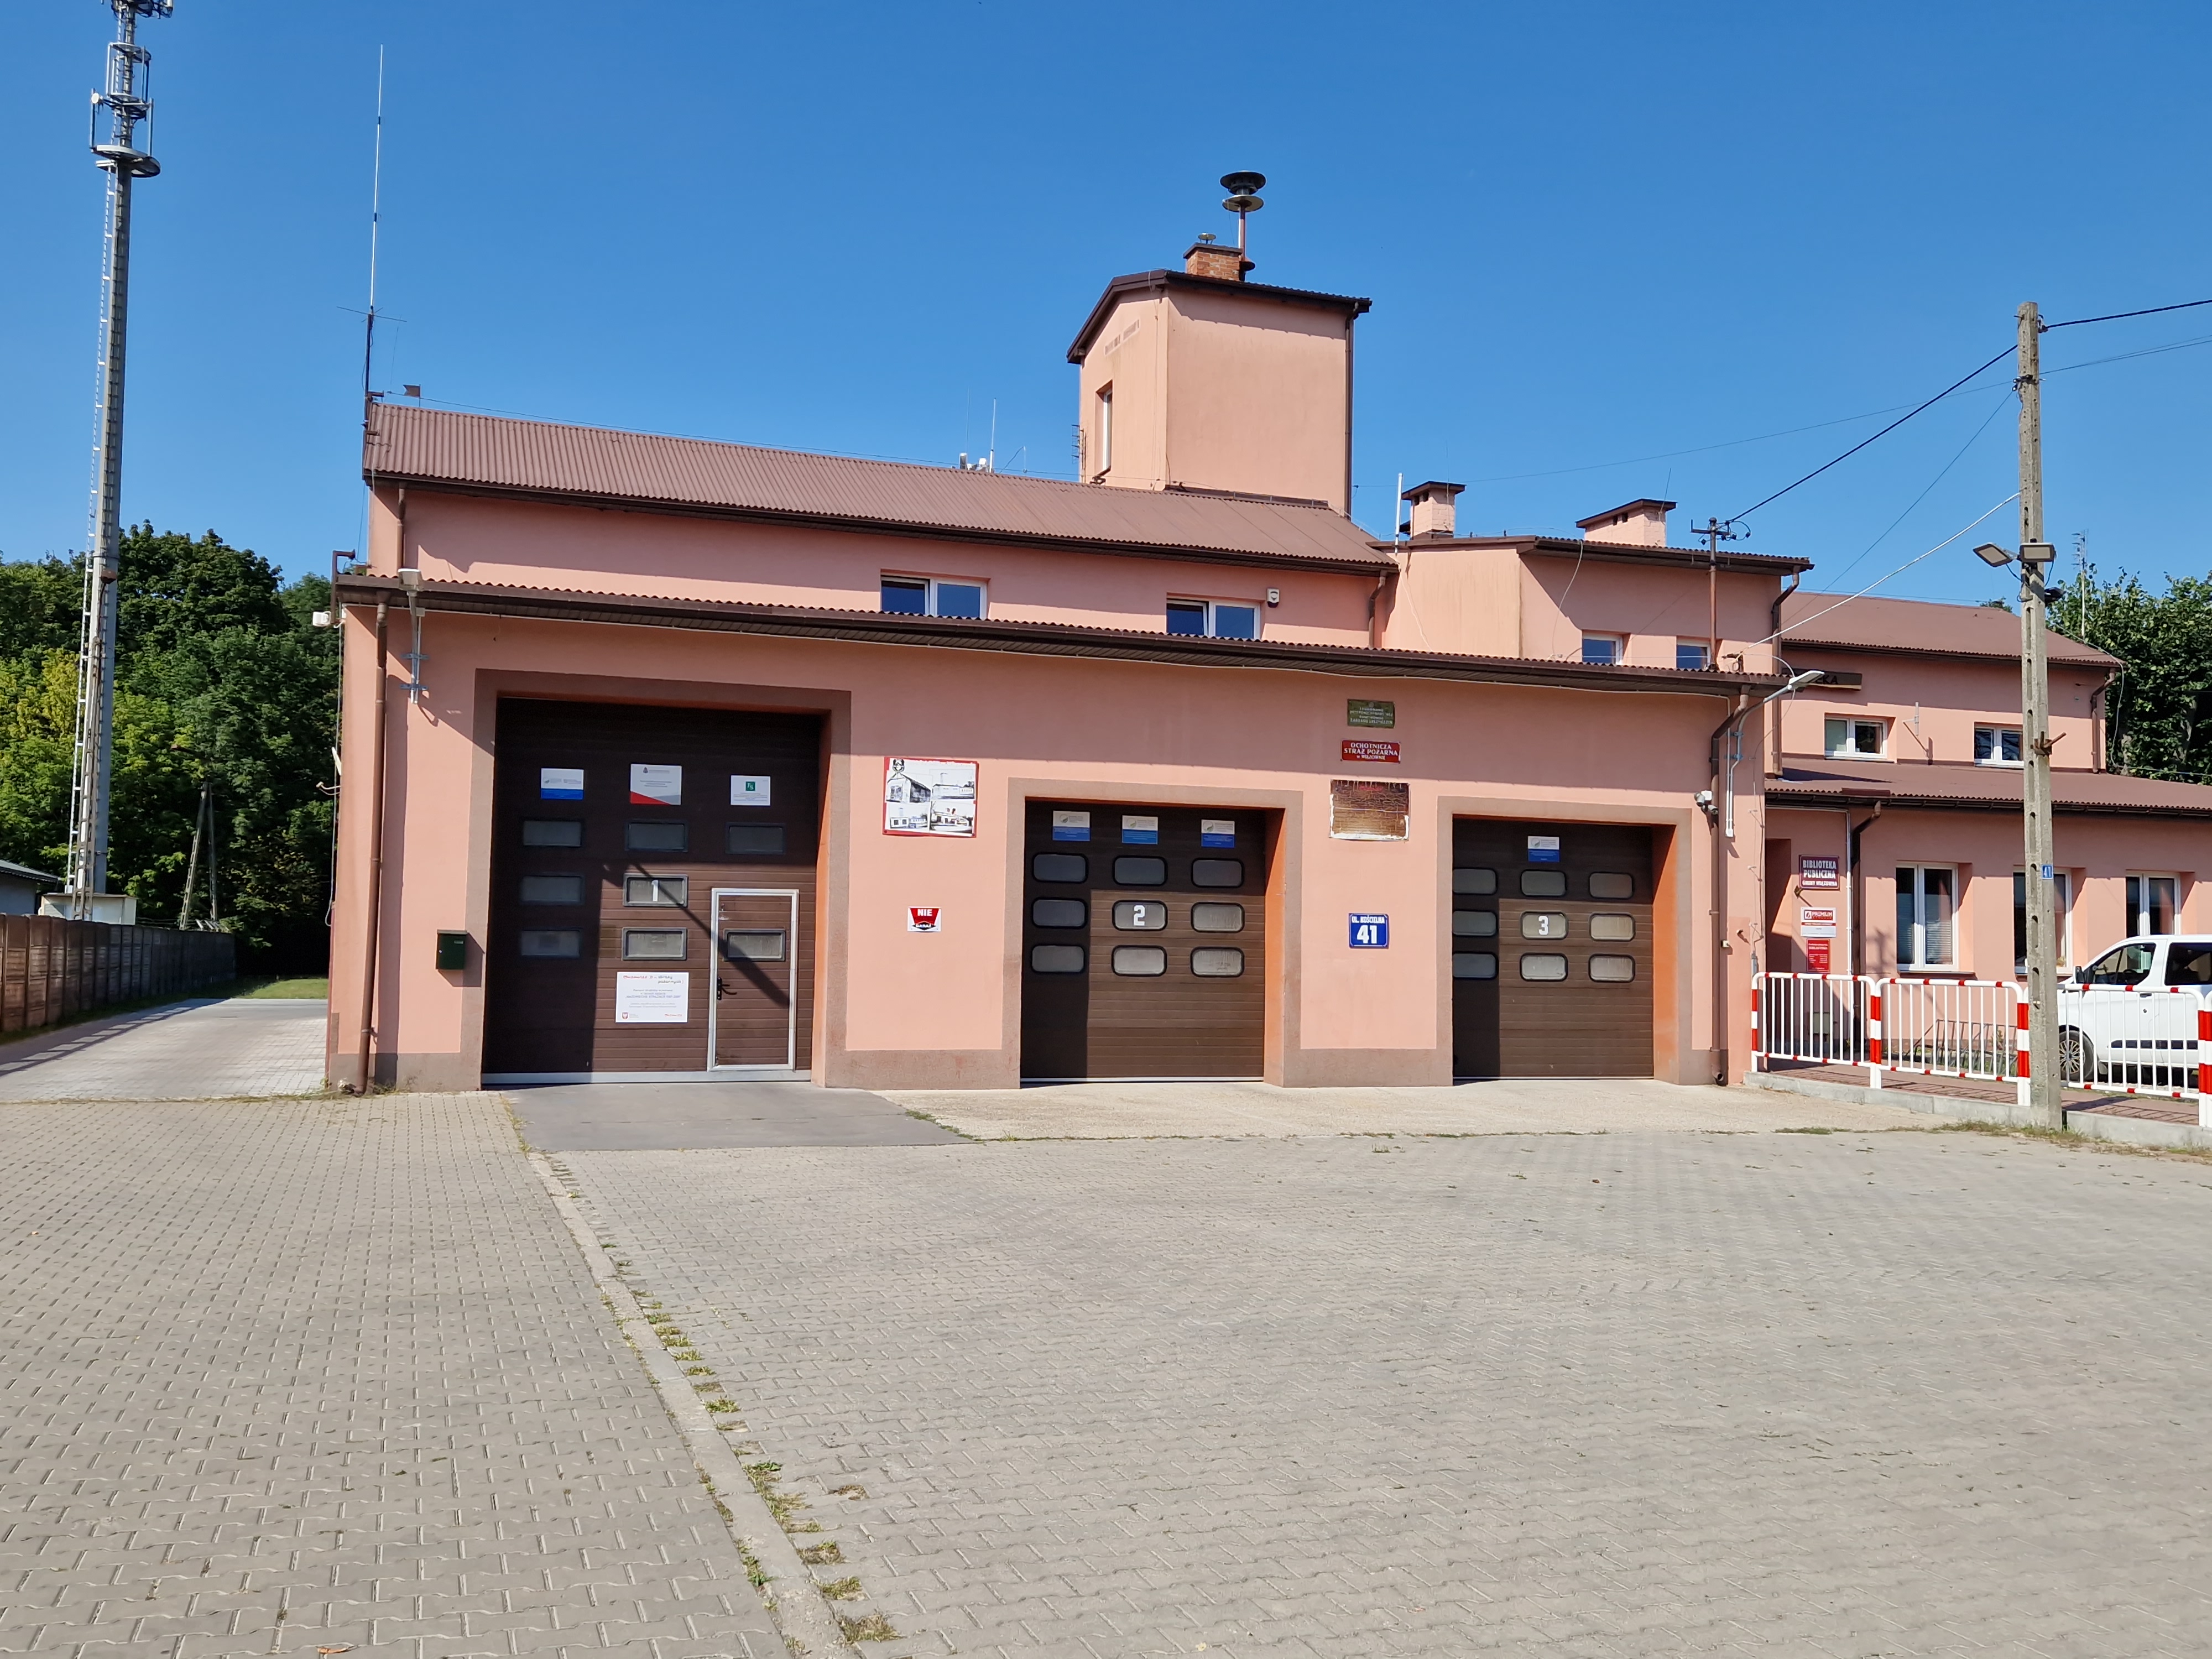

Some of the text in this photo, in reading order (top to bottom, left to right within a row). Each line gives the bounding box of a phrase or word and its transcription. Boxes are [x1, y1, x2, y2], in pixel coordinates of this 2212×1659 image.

[1802, 859, 1837, 869] BIBLIOTEKA
[1803, 869, 1836, 879] PUBLICZNA
[651, 880, 659, 902] 1
[1133, 905, 1145, 926] 2
[1357, 925, 1377, 944] 41
[1538, 916, 1549, 935] 3
